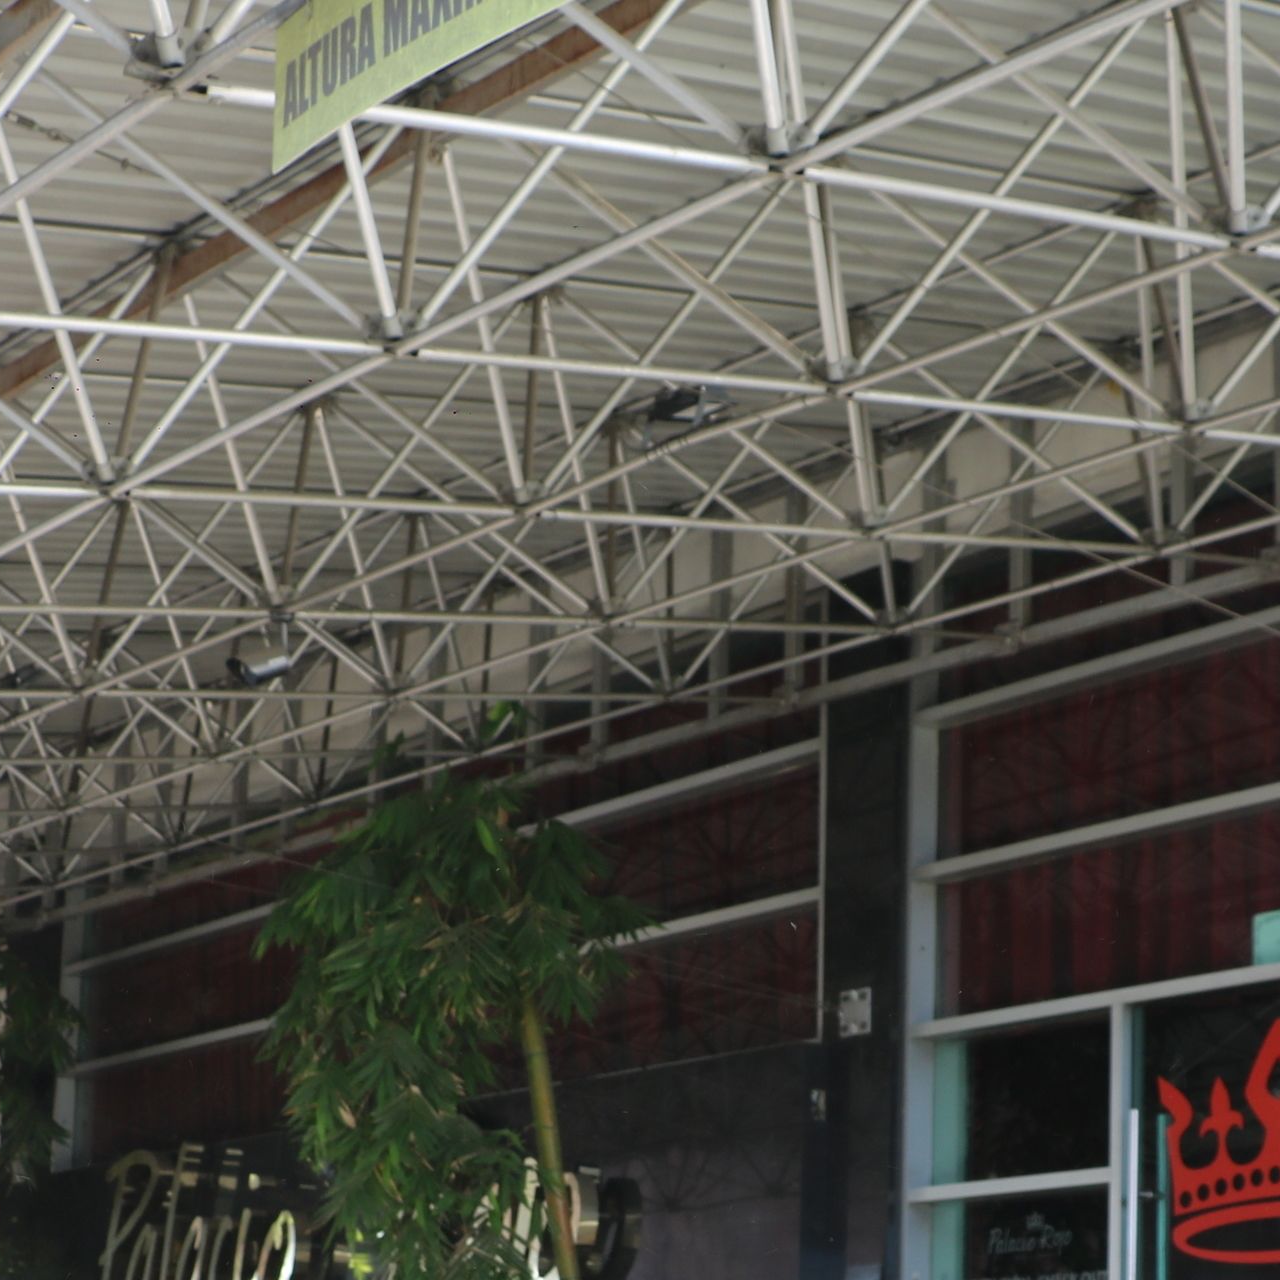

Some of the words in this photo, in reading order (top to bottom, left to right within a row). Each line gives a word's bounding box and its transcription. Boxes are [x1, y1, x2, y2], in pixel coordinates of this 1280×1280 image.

[283, 3, 377, 128] ALTURA
[987, 1228, 1036, 1255] Palacio
[1040, 1225, 1073, 1256] Rojo
